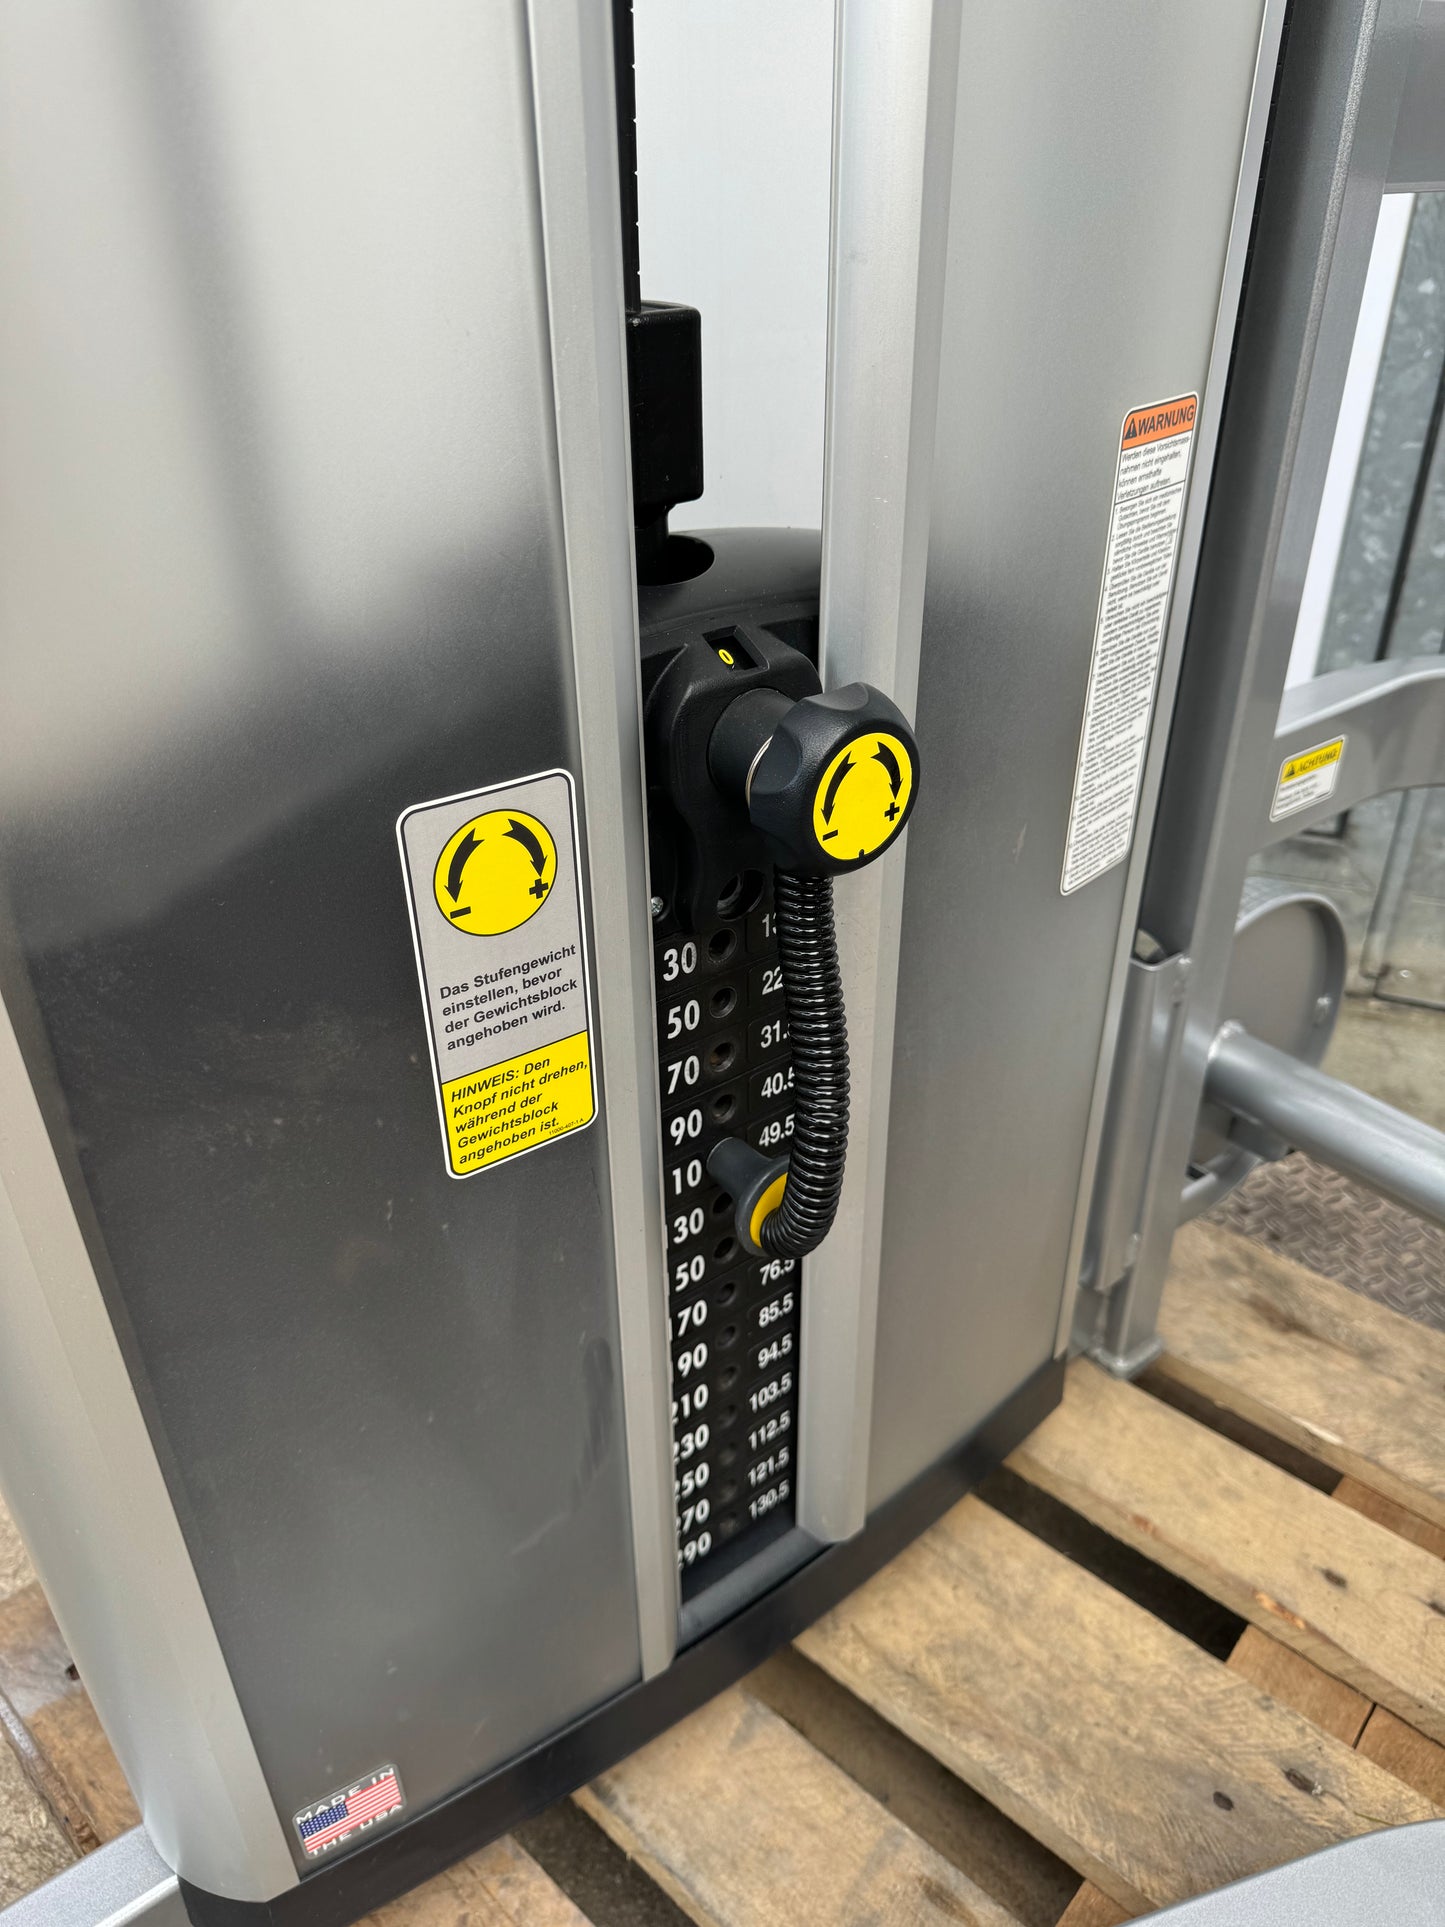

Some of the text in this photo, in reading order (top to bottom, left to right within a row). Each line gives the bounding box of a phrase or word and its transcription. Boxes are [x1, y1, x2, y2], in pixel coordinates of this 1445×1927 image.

[1138, 404, 1195, 436] WARNUNG
[762, 912, 777, 937] 1
[440, 944, 576, 999] Das Stufengewicht
[662, 941, 697, 982] 30
[762, 965, 783, 995] 22
[442, 967, 563, 1017] einstellen, bevor
[444, 978, 578, 1034] der Gewichtsblock
[447, 1001, 566, 1050] angehoben wird.
[666, 999, 700, 1040] 50
[760, 1020, 791, 1048] 31.
[451, 1058, 551, 1102] HINWEIS: Den
[453, 1060, 588, 1118] Knopf nicht drehen,
[667, 1055, 700, 1095] 70
[455, 1092, 543, 1134] während der
[458, 1100, 559, 1149] Gewichtsblock
[669, 1108, 703, 1146] 90
[759, 1113, 795, 1147] 49.5
[459, 1117, 560, 1164] angehoben ist.
[672, 1159, 702, 1195] 10
[673, 1207, 705, 1244] 30
[675, 1254, 706, 1292] 50
[759, 1258, 795, 1286] 76.5
[677, 1299, 708, 1337] 70
[758, 1292, 793, 1328] 85.5
[677, 1342, 708, 1378] 90
[757, 1332, 792, 1369] 94.5
[749, 1371, 792, 1413] 103.5
[748, 1409, 791, 1451] 112.5
[747, 1445, 789, 1487] 121.5
[748, 1479, 790, 1520] 130.5
[295, 1767, 394, 1825] MADE IN
